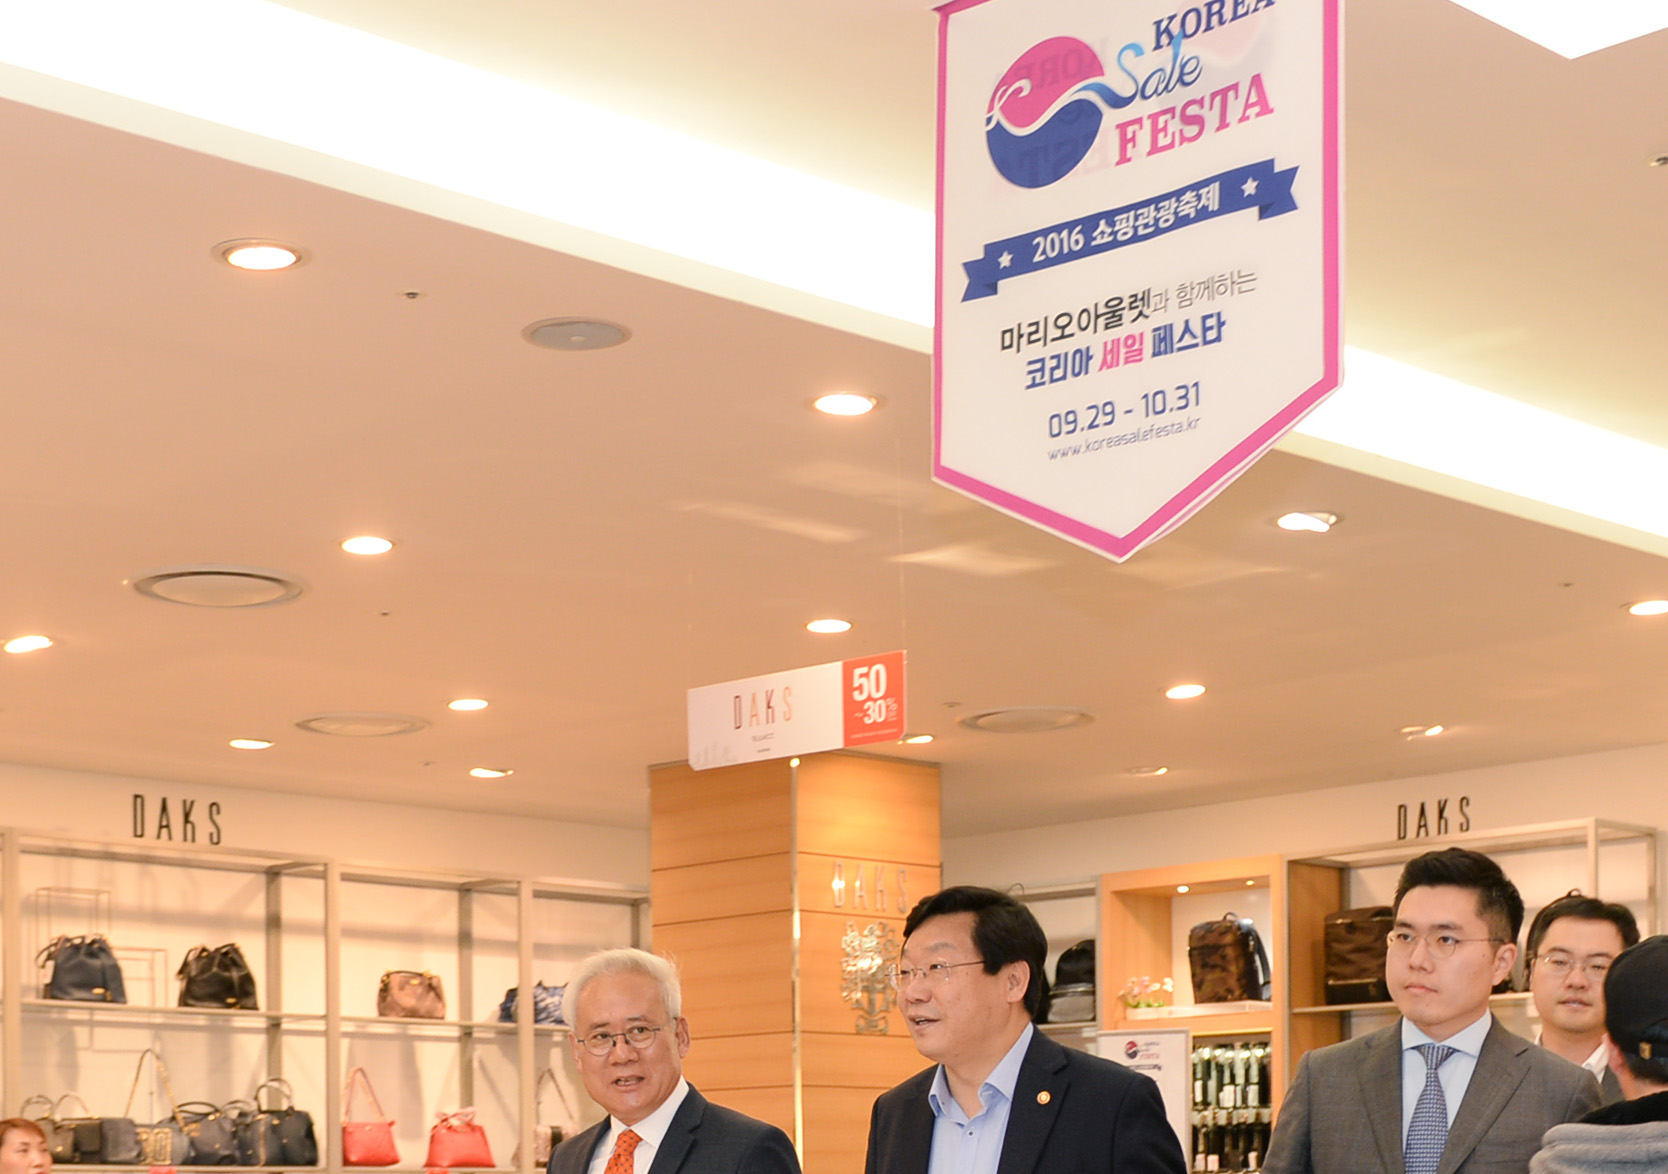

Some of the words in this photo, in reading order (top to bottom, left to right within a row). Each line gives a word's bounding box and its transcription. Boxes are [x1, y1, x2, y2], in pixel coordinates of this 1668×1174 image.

[1076, 28, 1203, 110] Sale
[1115, 72, 1274, 167] FESTA
[1032, 227, 1085, 263] 2016
[1091, 181, 1220, 246] 쇼핑관광축제
[1175, 270, 1257, 309] 함께하는
[1025, 346, 1093, 390] 코리아
[1098, 331, 1146, 373] 세일
[1150, 311, 1227, 358] 페스타
[1048, 400, 1116, 439] 09.29
[1140, 381, 1200, 418] 10.31
[1048, 416, 1200, 461] www.koreasalefesta.kr
[733, 685, 793, 730] DAKS
[852, 663, 887, 702] 50
[132, 793, 222, 846] DAKS
[1397, 796, 1470, 841] DAKS
[832, 861, 908, 914] DAKS
